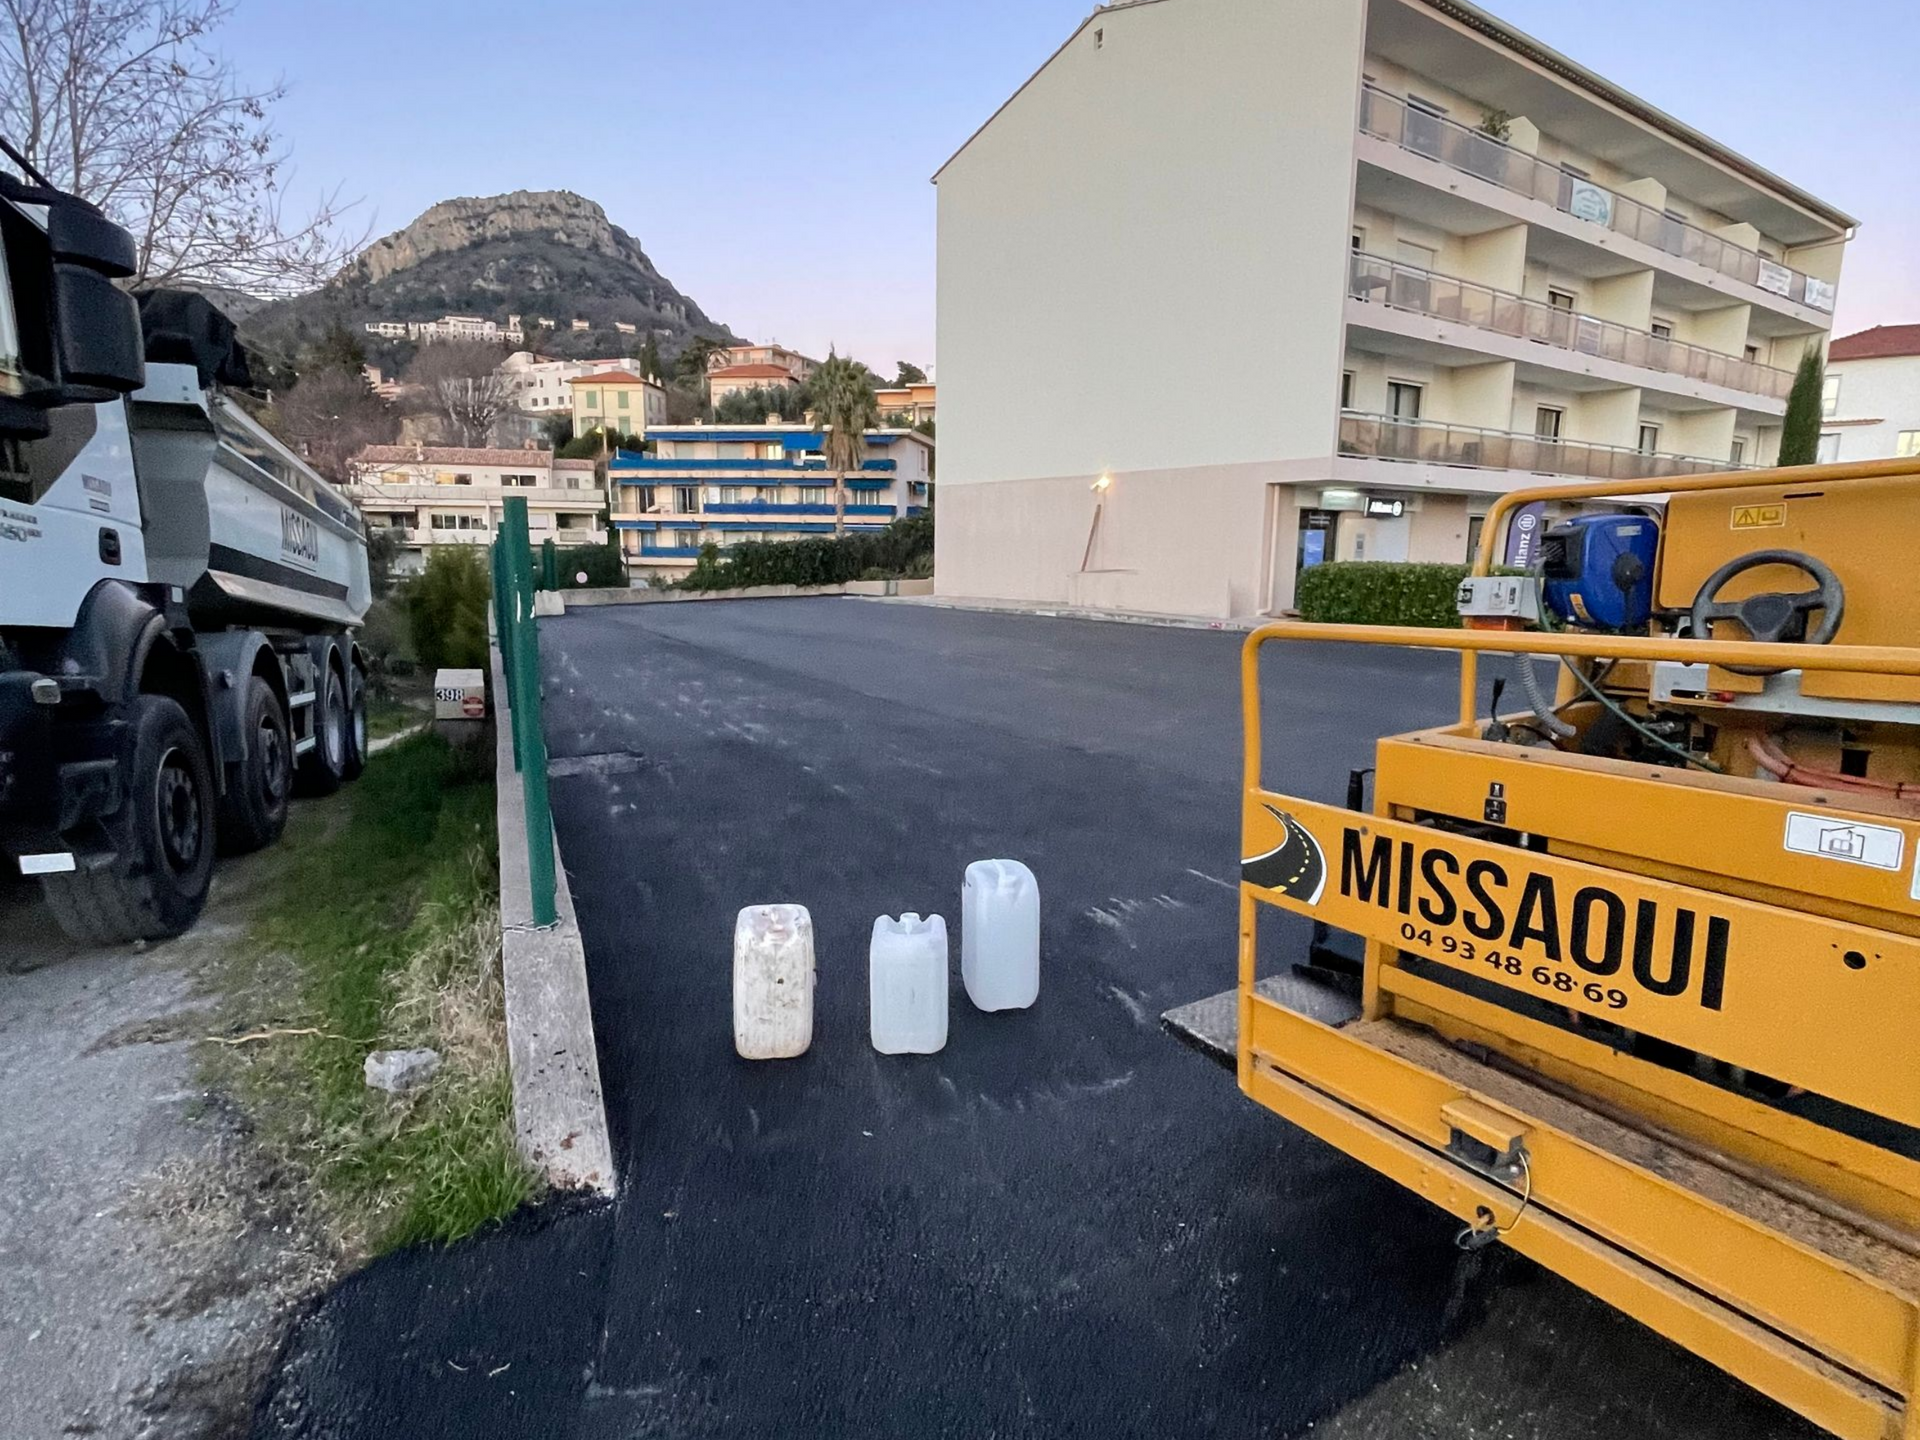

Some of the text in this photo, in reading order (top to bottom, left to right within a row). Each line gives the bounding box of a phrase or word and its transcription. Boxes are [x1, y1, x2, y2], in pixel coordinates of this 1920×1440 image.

[1514, 532, 1531, 568] llianz
[437, 688, 464, 701] 398
[1340, 827, 1730, 1011] MISSAOUI
[1400, 922, 1628, 1009] 04 93 48 68 69
